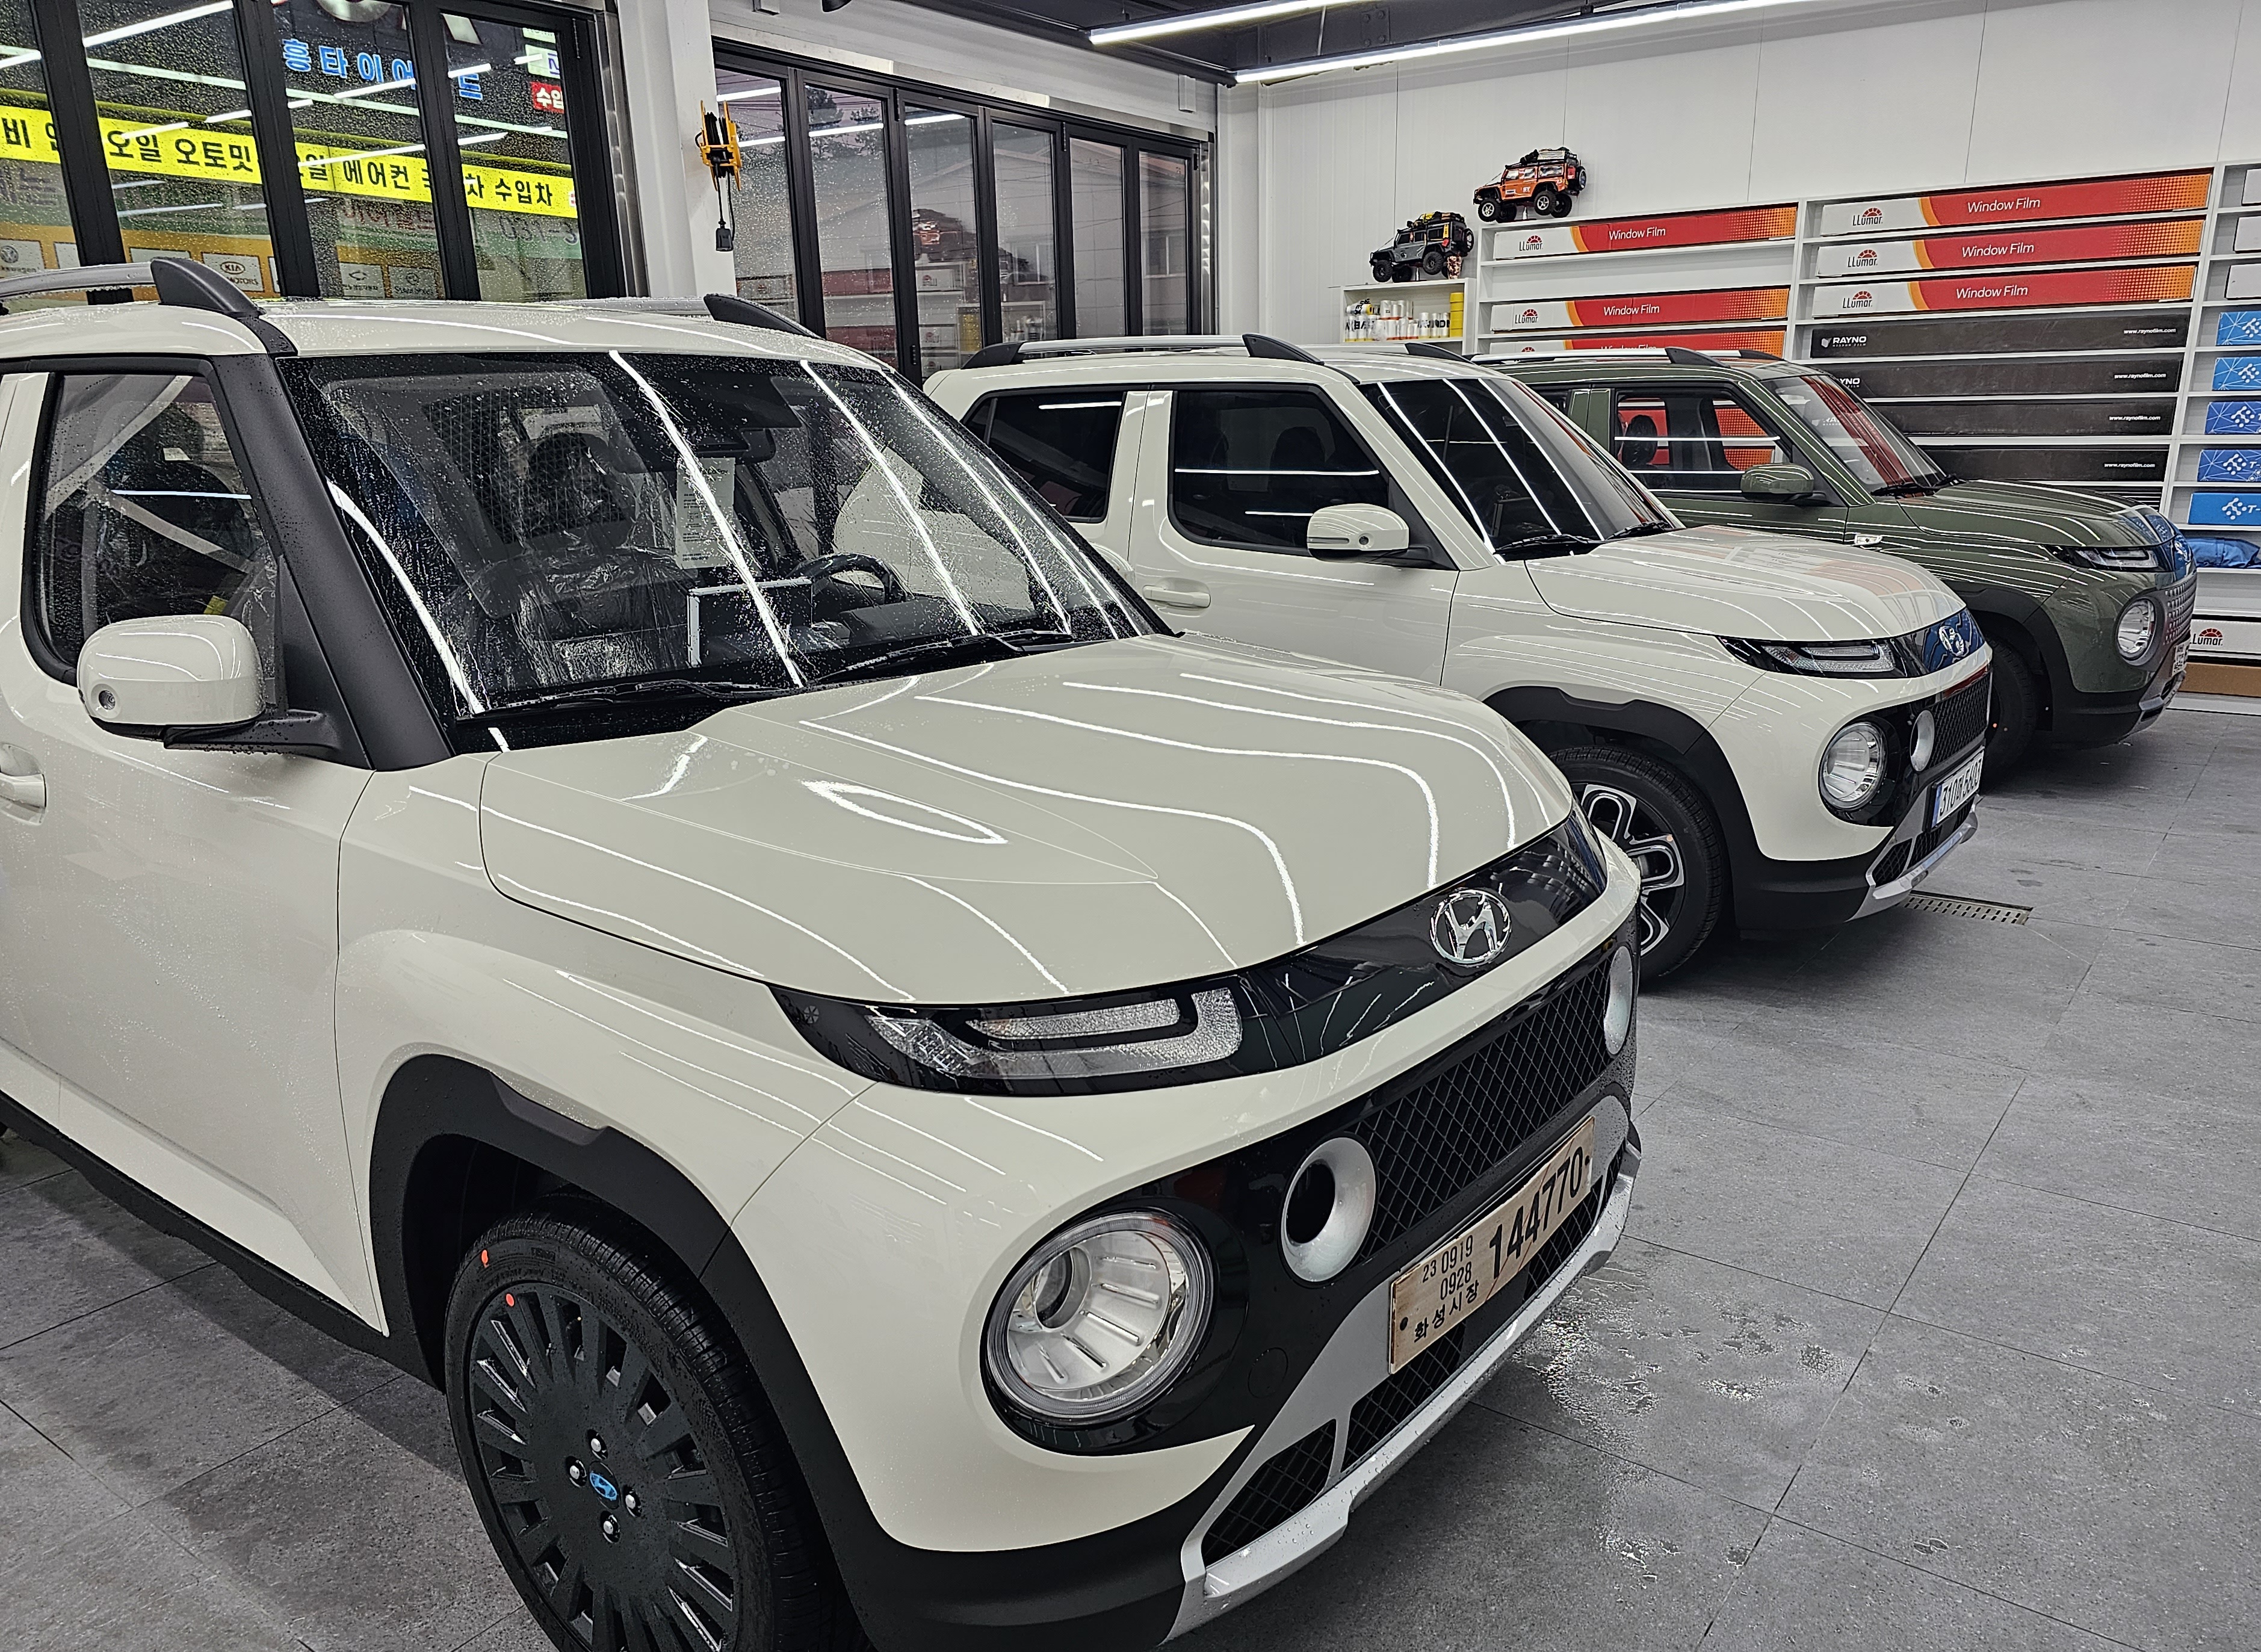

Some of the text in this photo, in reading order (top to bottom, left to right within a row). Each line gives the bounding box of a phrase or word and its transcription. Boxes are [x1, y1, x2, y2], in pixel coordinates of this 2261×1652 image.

[107, 130, 162, 163] 오일
[342, 159, 410, 190] 에어컨
[495, 178, 552, 206] 수입차
[1852, 197, 2040, 226] LLumar Window Film
[1519, 226, 1666, 252] LLumar Window Film
[224, 264, 241, 272] KIA
[1848, 243, 2034, 267] LLumar Window Film
[1843, 284, 2028, 308] LLumar Window Film
[1515, 304, 1660, 324] LLumar Window Film
[1833, 336, 1867, 344] RAYNO
[2189, 633, 2223, 646] Lumar
[1489, 1146, 1583, 1280] 144770
[1422, 1235, 1473, 1283] 23 0919
[1440, 1261, 1472, 1301] 0928
[1414, 1279, 1479, 1343] 화성시장
